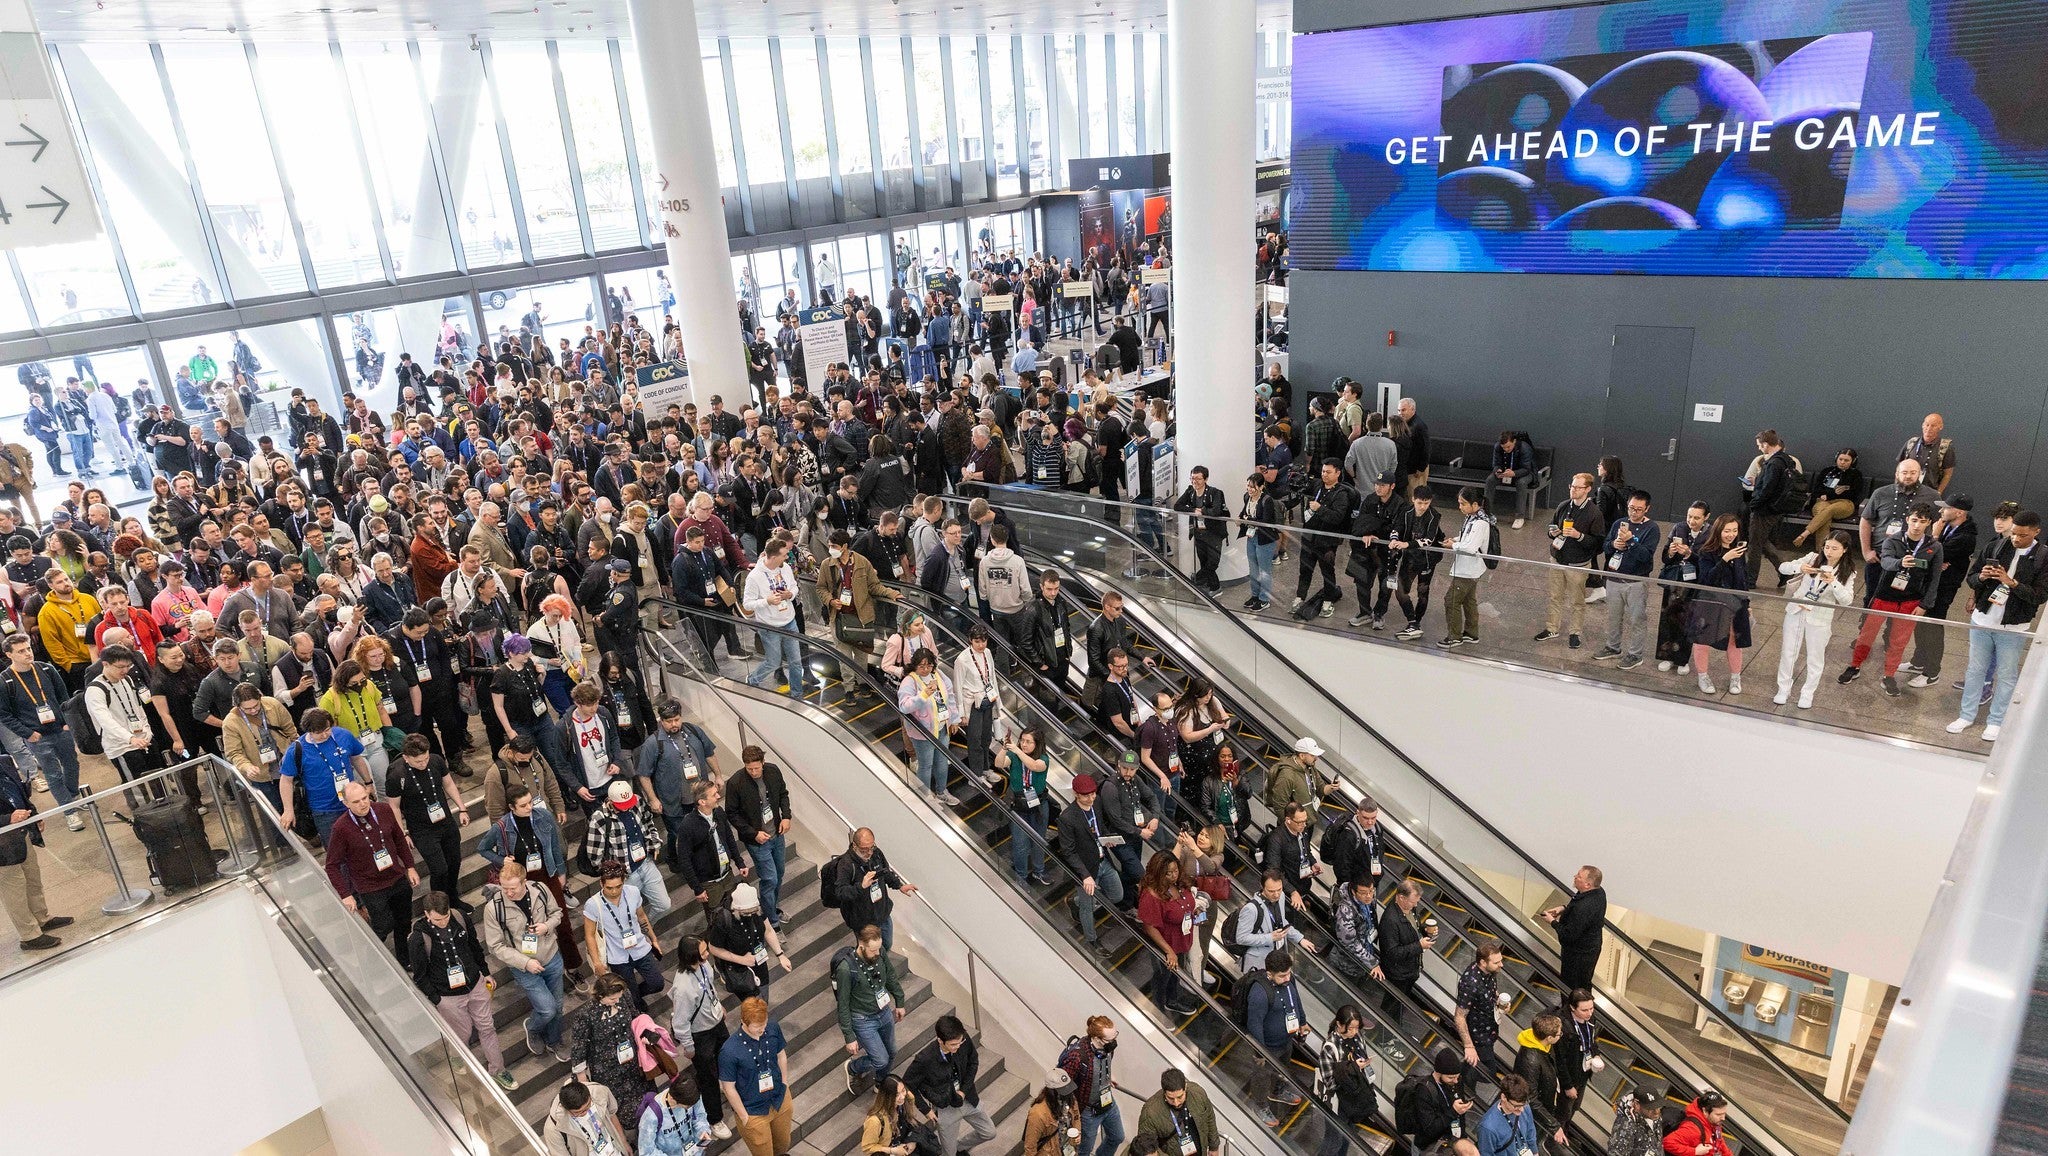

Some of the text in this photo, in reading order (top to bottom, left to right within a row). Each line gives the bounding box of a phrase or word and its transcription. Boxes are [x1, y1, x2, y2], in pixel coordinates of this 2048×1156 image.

[1384, 111, 1941, 165] GET AHEAD OF THE GAME
[811, 310, 832, 322] GDC
[652, 366, 675, 380] GDC
[665, 384, 688, 394] CONDUCT
[376, 851, 388, 859] GDC
[1766, 949, 1828, 974] Hydrated
